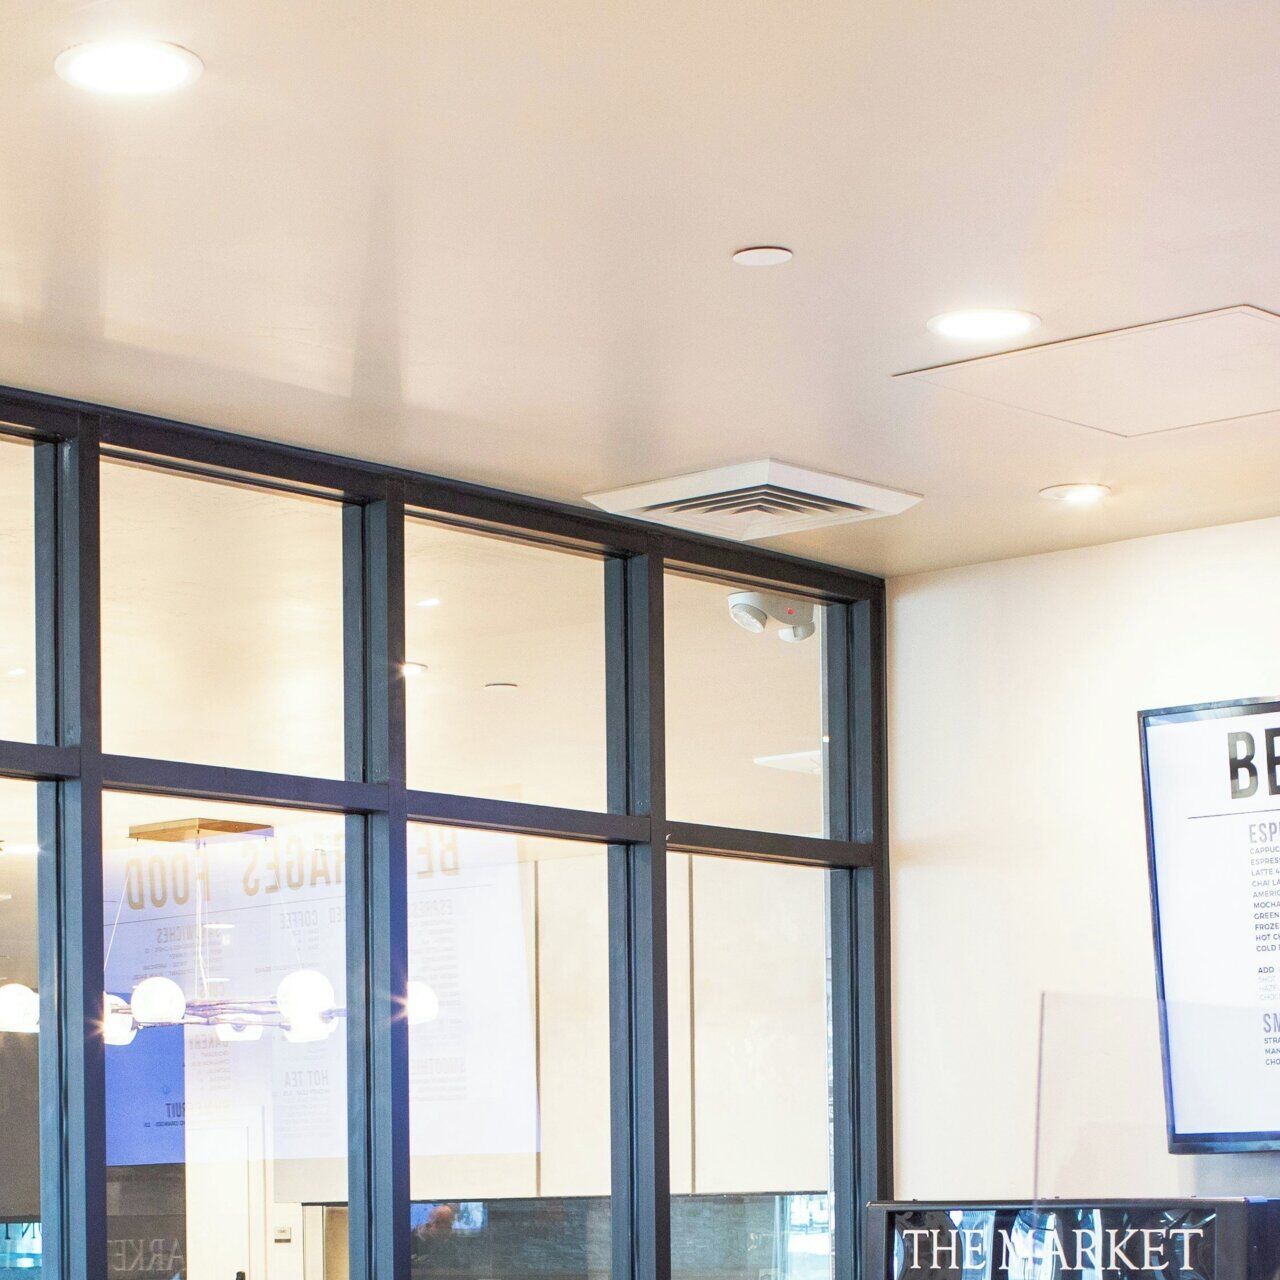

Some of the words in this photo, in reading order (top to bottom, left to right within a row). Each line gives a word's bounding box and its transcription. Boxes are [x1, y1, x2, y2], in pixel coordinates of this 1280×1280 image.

[1251, 868, 1273, 876] LATTE
[1253, 911, 1279, 919] GREEN
[1255, 933, 1270, 941] HOT
[1256, 944, 1276, 952] COLD
[903, 1229, 986, 1270] THE
[998, 1228, 1204, 1271] MARKET
